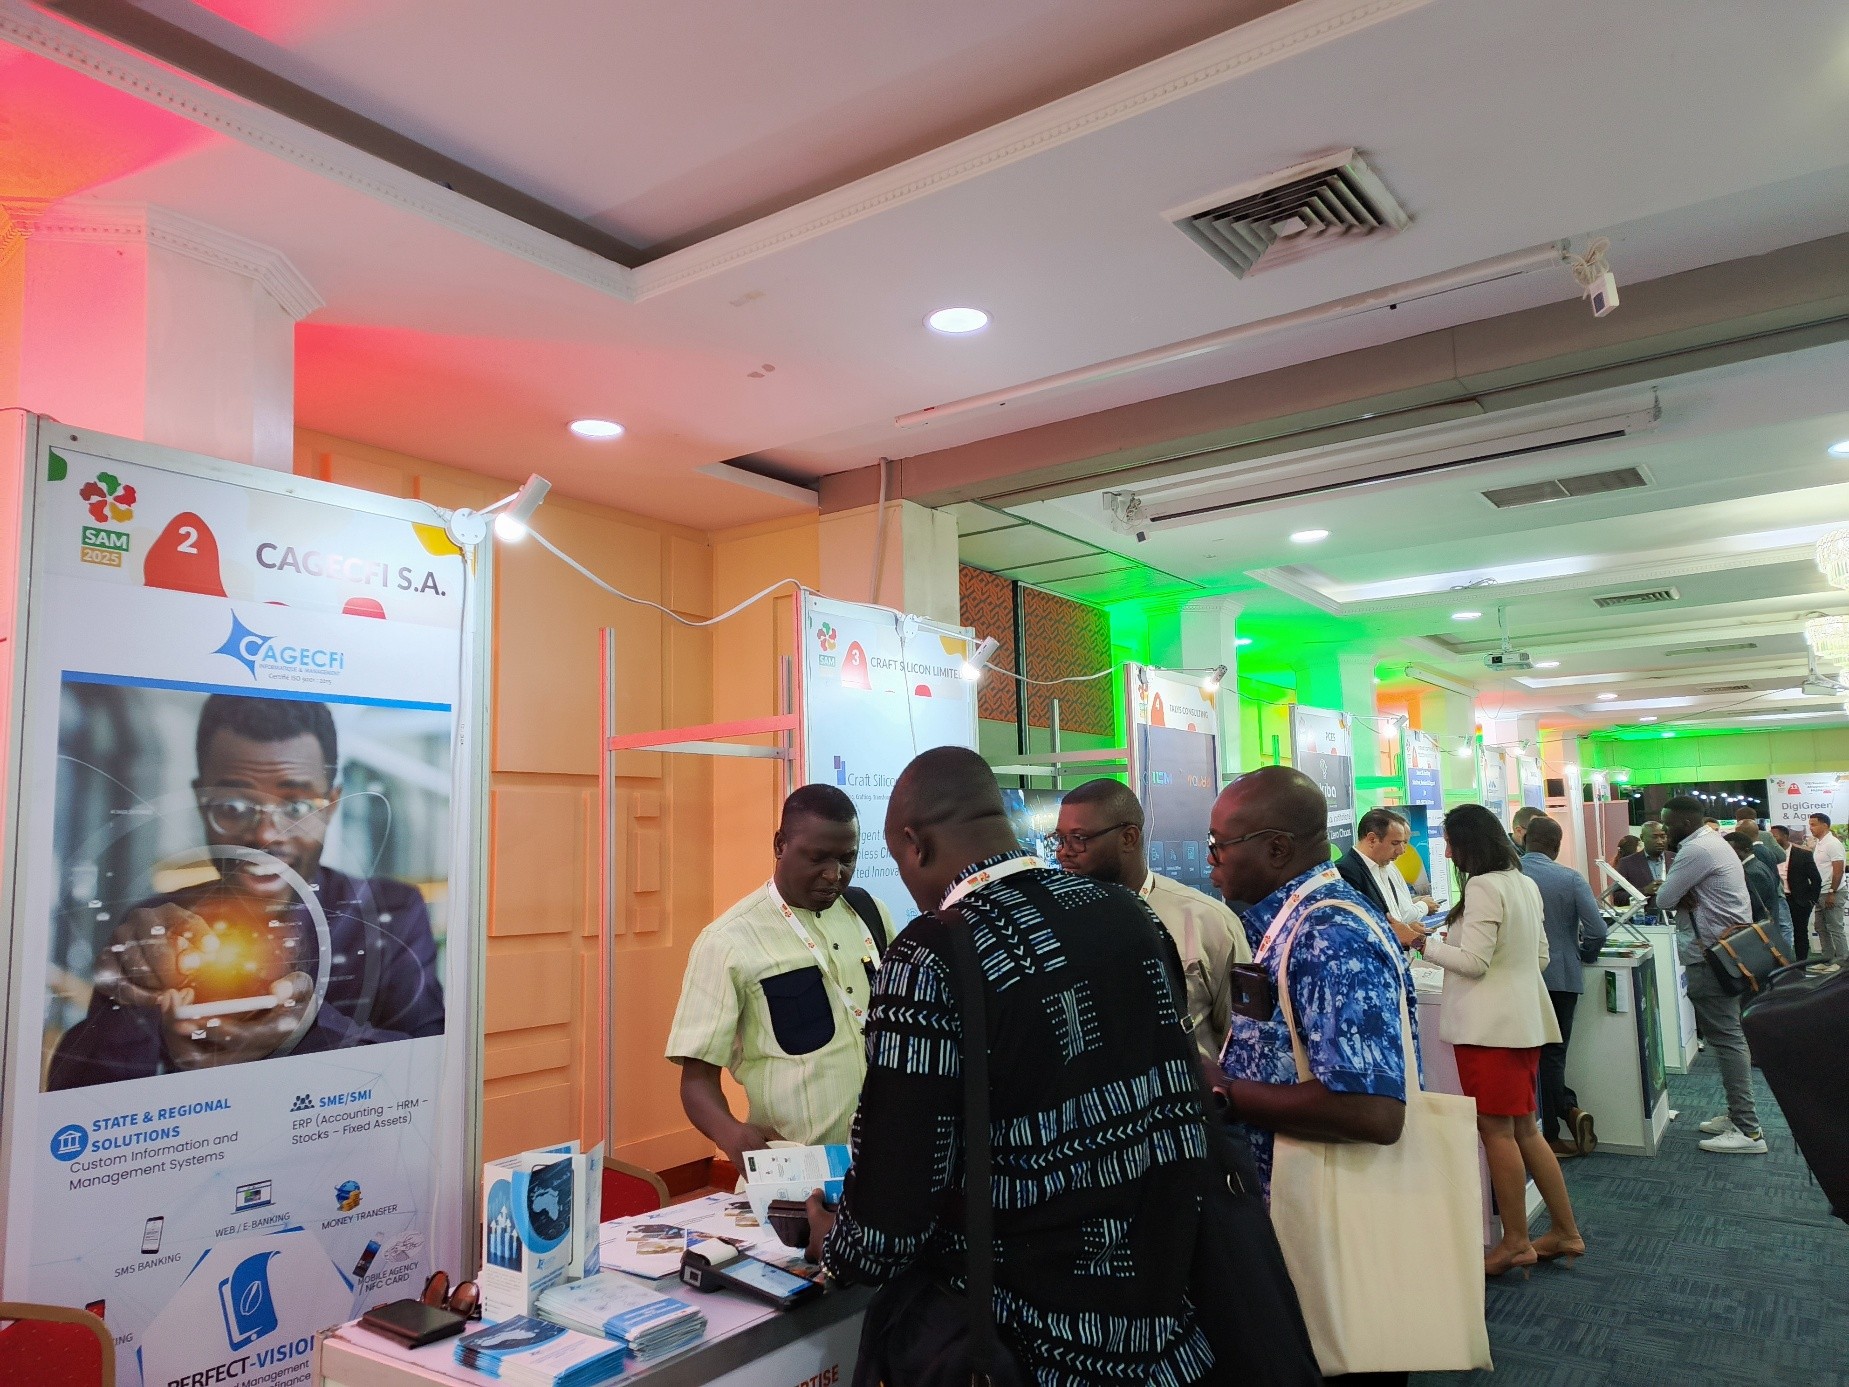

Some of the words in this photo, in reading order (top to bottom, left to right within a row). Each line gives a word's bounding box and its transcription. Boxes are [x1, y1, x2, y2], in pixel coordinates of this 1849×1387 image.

[84, 529, 128, 549] SAM
[177, 526, 198, 554] 2
[83, 549, 120, 564] 2025
[256, 542, 389, 588] CAGECFI
[397, 566, 447, 597] S.A.
[819, 655, 836, 667] SAM
[852, 649, 860, 666] 3
[870, 656, 898, 671] CRAFT
[847, 772, 871, 787] Craft
[873, 773, 900, 788] Silico
[859, 829, 880, 845] gent
[871, 865, 900, 878] Innova
[319, 1088, 372, 1108] SME/SMI
[92, 1112, 139, 1133] STATE
[142, 1110, 154, 1124] &
[157, 1097, 232, 1121] REGIONAL
[292, 1116, 313, 1131] ERP
[315, 1105, 384, 1128] (Accounting
[396, 1098, 419, 1111] HRM
[291, 1128, 330, 1145] Stocks
[342, 1120, 371, 1135] Fixed
[373, 1110, 412, 1129] Assets)
[90, 1125, 181, 1153] SOLUTIONS
[70, 1152, 128, 1174] Custom
[131, 1139, 210, 1161] Information
[212, 1131, 239, 1147] and
[69, 1161, 167, 1191] Management
[169, 1150, 225, 1172] Systems
[321, 1215, 354, 1231] MONEY
[355, 1203, 398, 1221] TRANSFER
[215, 1226, 236, 1238] WEB
[114, 1264, 136, 1278] SMS
[137, 1252, 182, 1273] BANKING
[358, 1270, 387, 1286] MOBILE
[388, 1261, 420, 1278] AGENCY
[385, 1273, 410, 1287] CARD
[112, 1332, 134, 1346] ING
